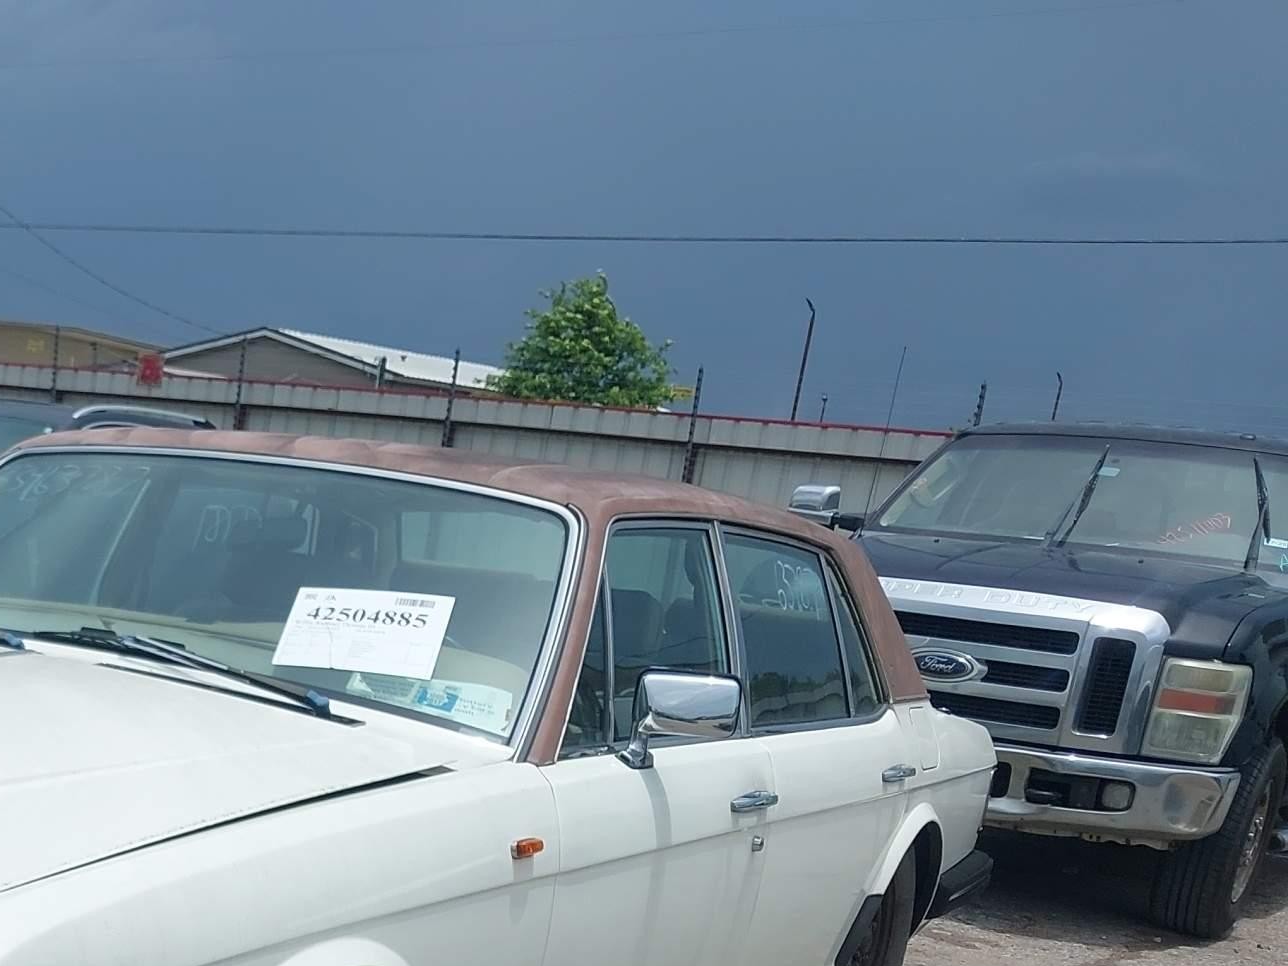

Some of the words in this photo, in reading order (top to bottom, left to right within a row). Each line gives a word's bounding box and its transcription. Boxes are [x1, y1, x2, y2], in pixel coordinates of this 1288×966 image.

[983, 591, 1096, 613] DUTY
[306, 606, 429, 629] 42504885
[920, 655, 957, 673] Ford
